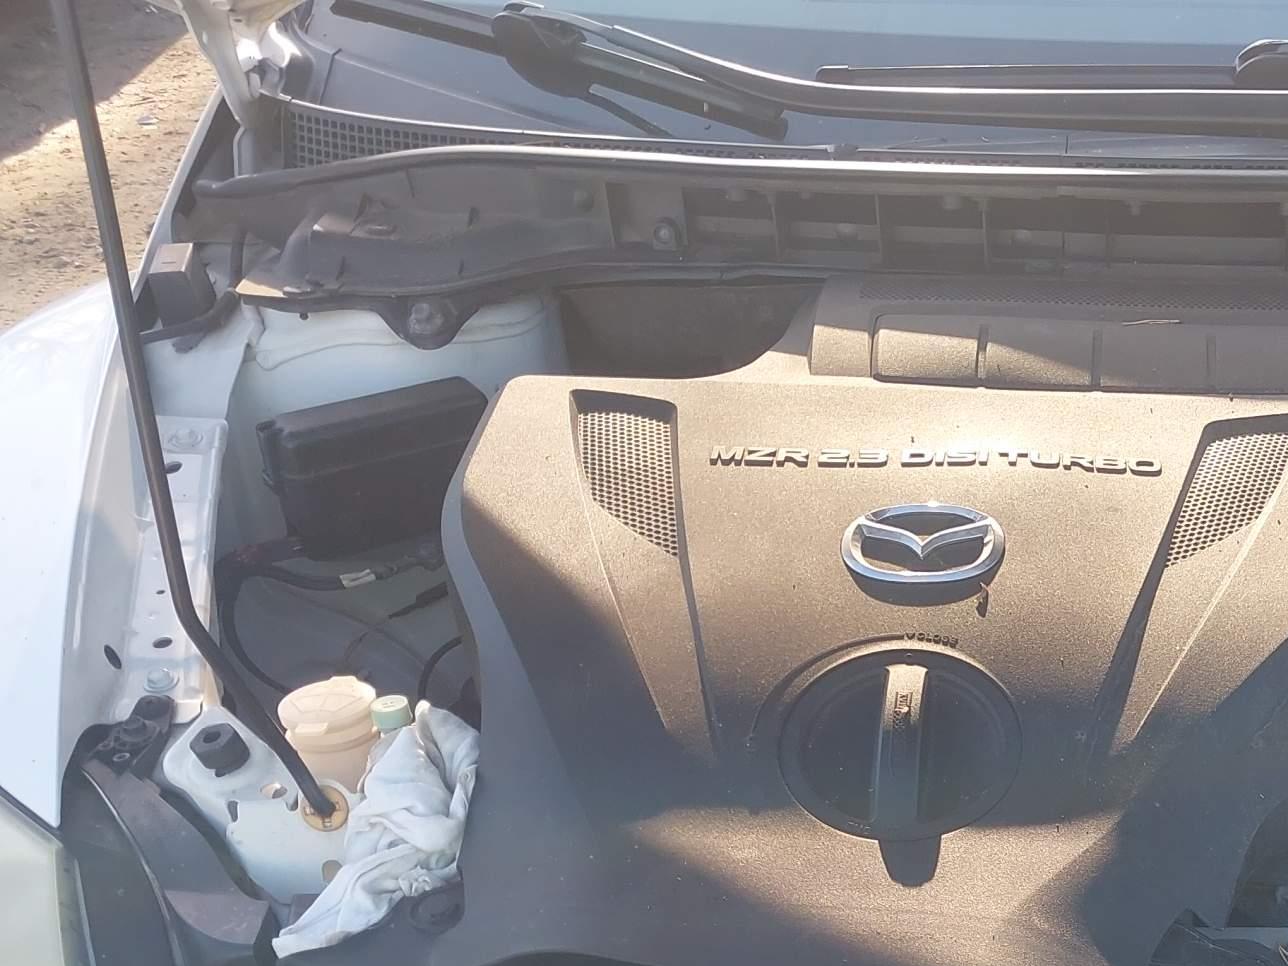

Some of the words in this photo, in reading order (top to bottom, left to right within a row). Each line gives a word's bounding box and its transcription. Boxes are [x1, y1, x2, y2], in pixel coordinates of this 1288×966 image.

[709, 445, 809, 467] MZR
[816, 447, 888, 467] 2.3
[900, 446, 989, 468] DISI
[997, 450, 1162, 477] TURBO
